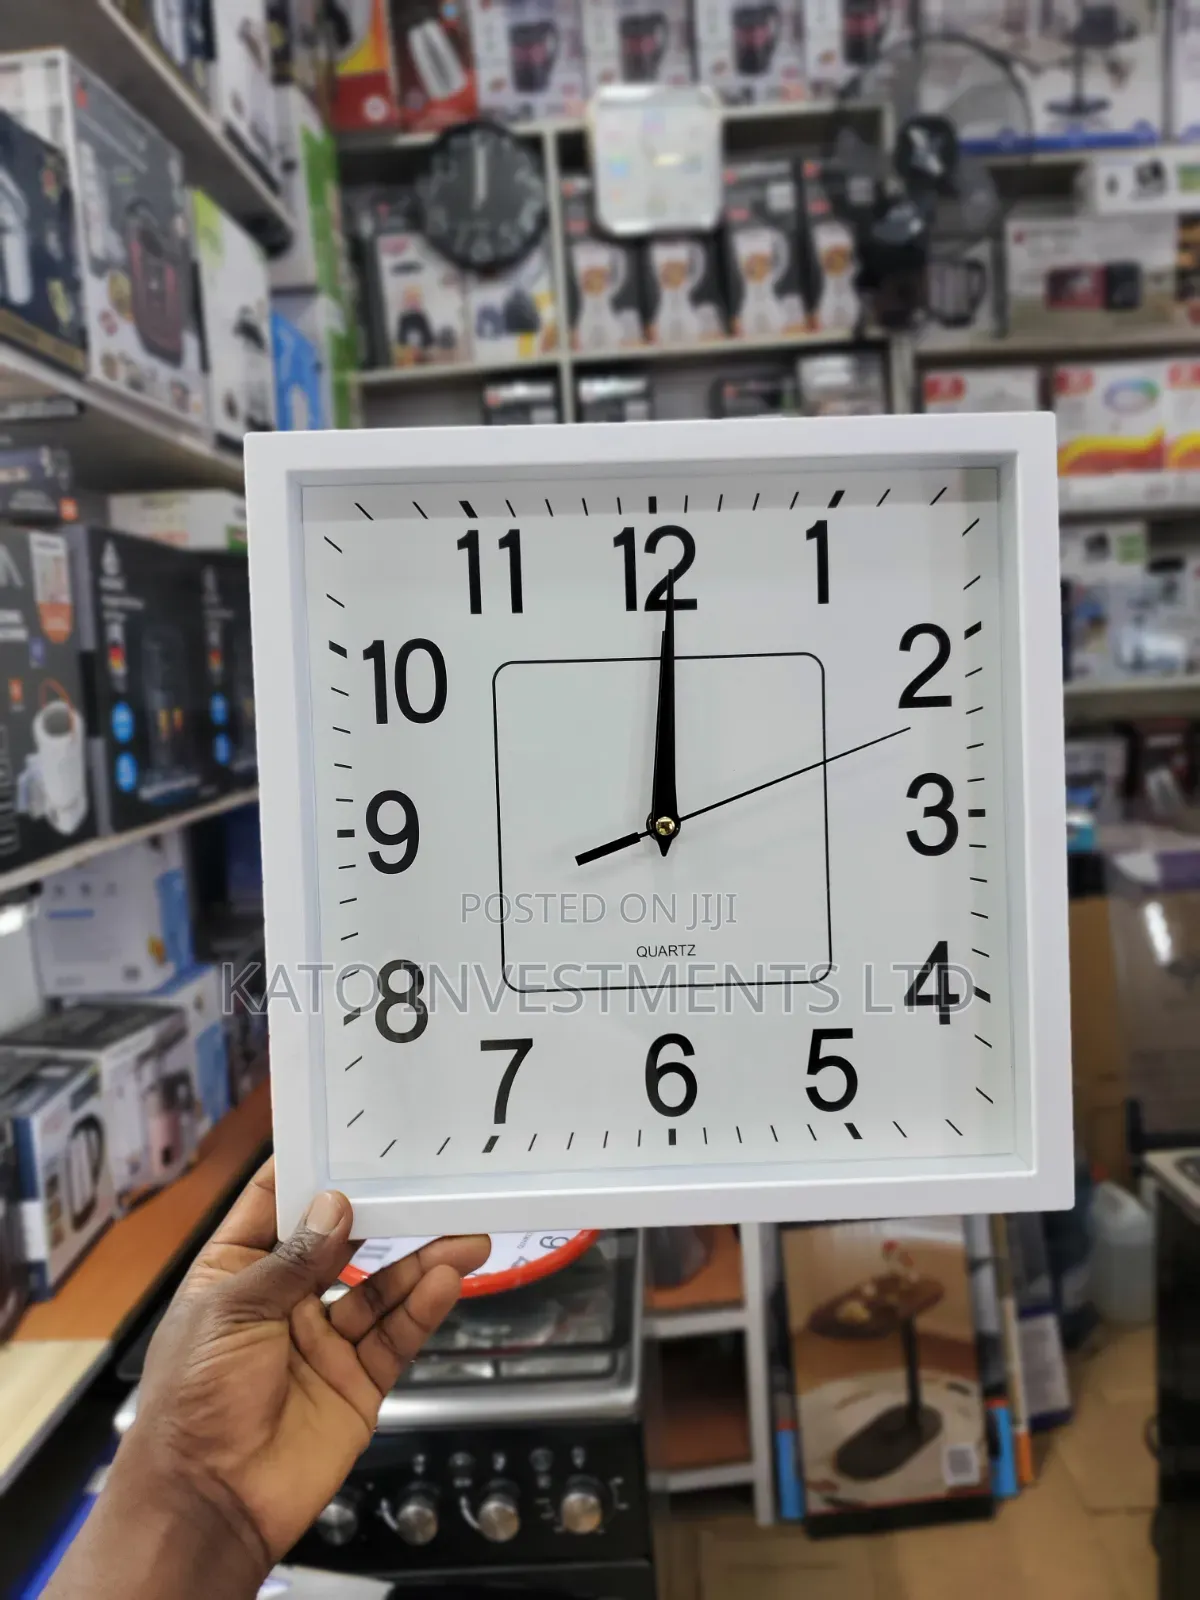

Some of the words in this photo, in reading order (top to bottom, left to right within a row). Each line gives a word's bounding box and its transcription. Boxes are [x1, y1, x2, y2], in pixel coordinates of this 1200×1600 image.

[456, 528, 524, 615] 11
[613, 524, 698, 613] 12
[805, 519, 830, 605] 1
[362, 637, 448, 725] 10
[897, 622, 953, 709] 2
[365, 789, 420, 875] 9
[905, 772, 959, 857] 3
[636, 944, 696, 958] QUARTZ
[903, 940, 960, 1026] 4
[374, 959, 429, 1044] 8
[480, 1037, 534, 1125] 7
[644, 1032, 698, 1118] 6
[805, 1027, 859, 1113] 5
